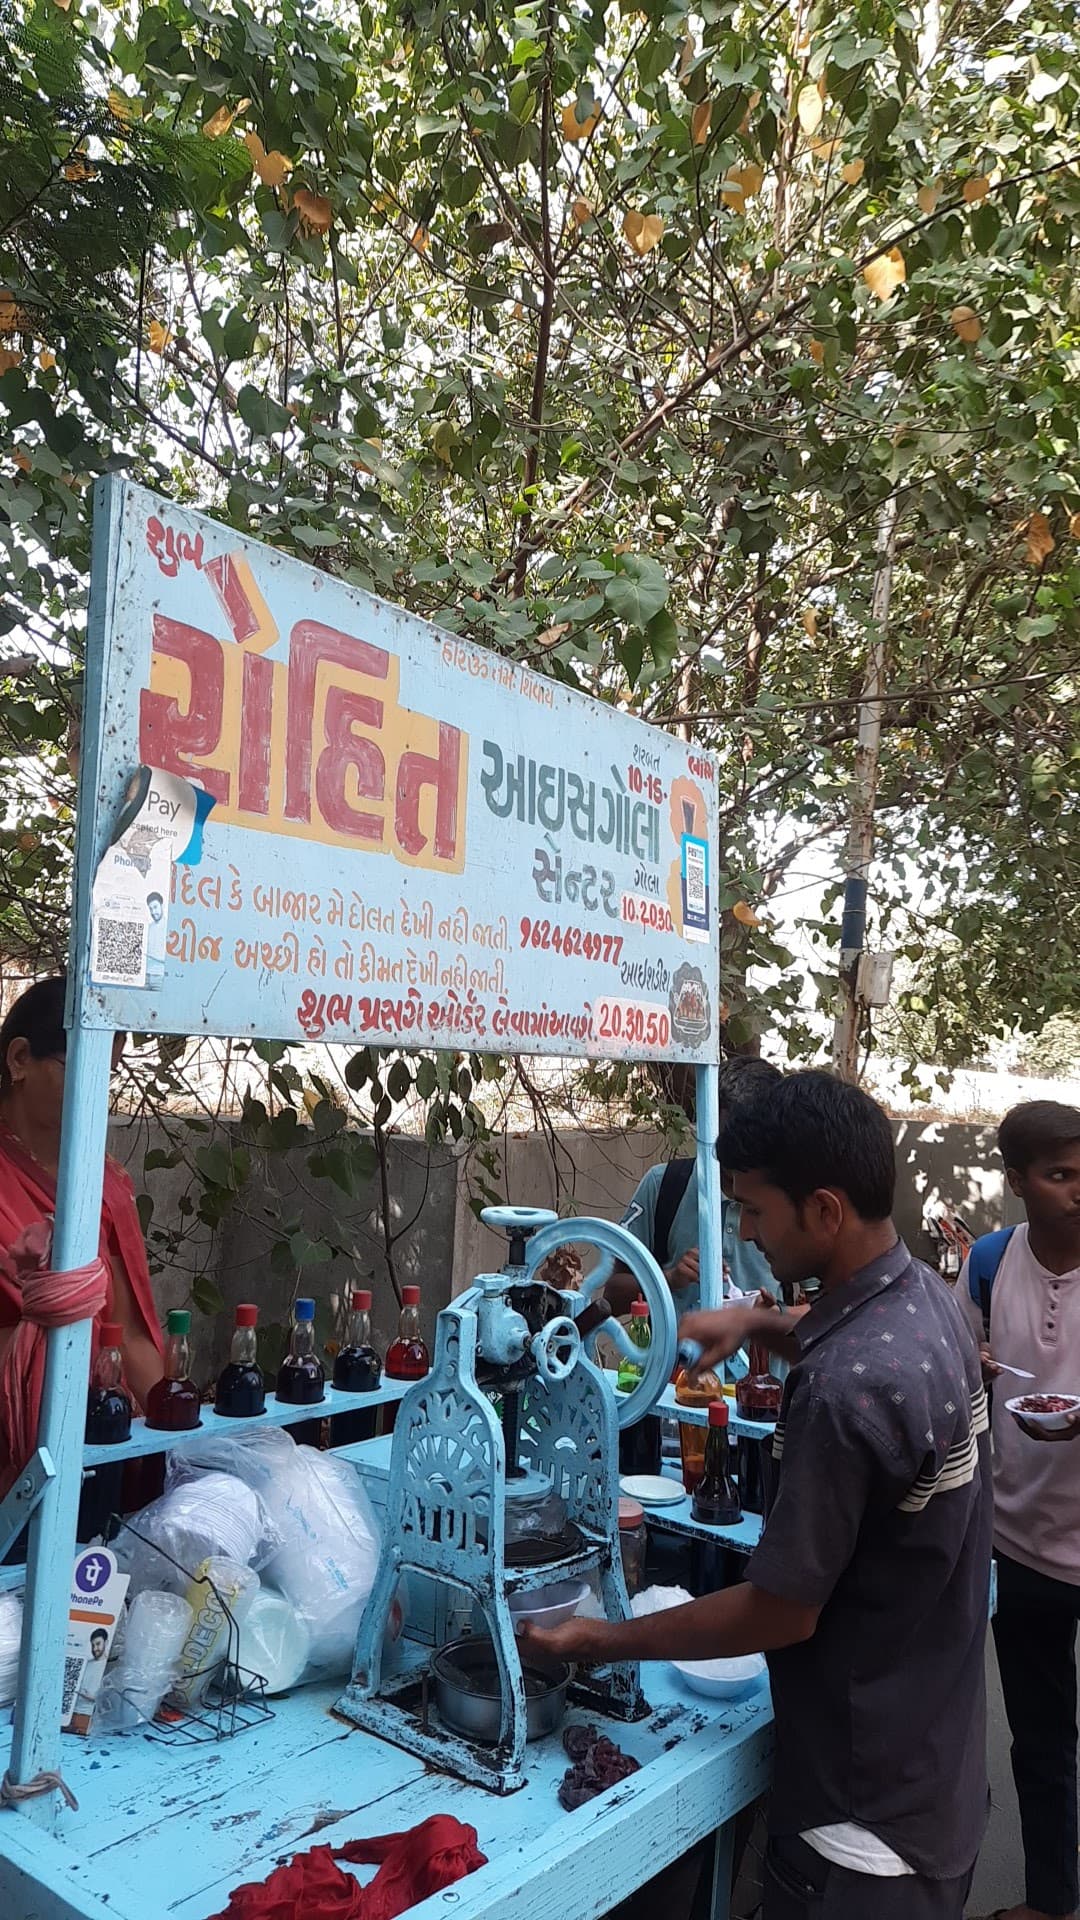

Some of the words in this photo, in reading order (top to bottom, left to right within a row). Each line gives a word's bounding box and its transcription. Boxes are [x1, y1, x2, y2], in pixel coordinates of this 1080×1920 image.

[139, 552, 461, 861] રોહિત
[633, 744, 660, 773] શરબત
[148, 791, 182, 822] Pay
[160, 826, 178, 838] here
[634, 861, 660, 895] ગોલા
[227, 863, 243, 911] કે
[253, 884, 321, 925] બાજાર
[349, 890, 395, 935] દોલત
[400, 897, 434, 941] દેખી
[439, 906, 468, 946] નહી
[307, 934, 327, 977] હો
[334, 939, 354, 980] તો
[520, 916, 624, 966] 9624624977
[297, 988, 352, 1039] શુભ
[600, 1003, 669, 1047] 20.30.50
[71, 1593, 104, 1606] honePe
